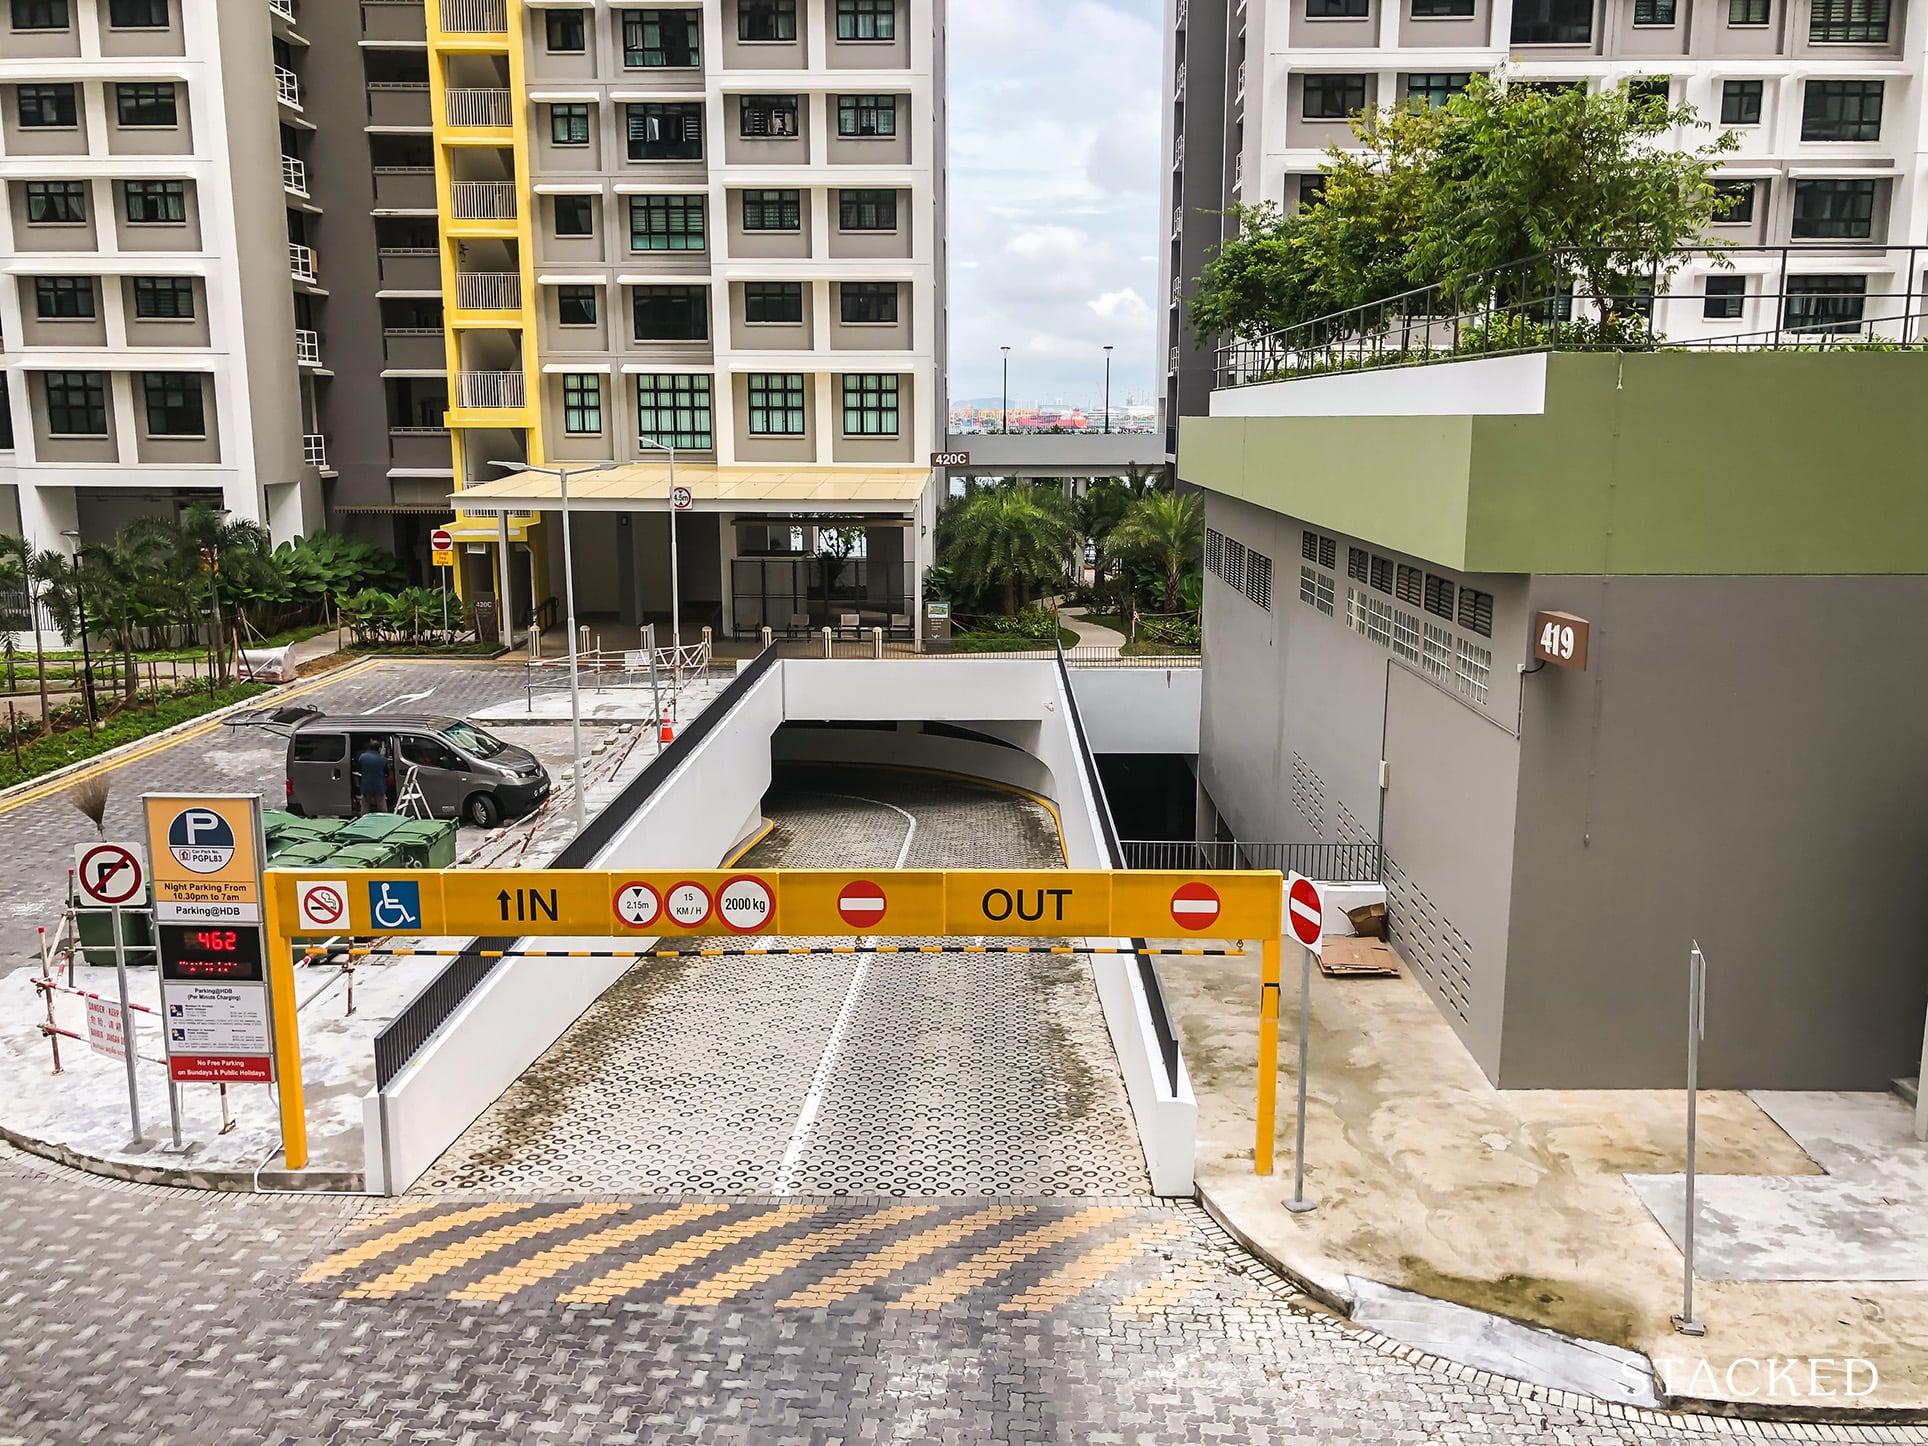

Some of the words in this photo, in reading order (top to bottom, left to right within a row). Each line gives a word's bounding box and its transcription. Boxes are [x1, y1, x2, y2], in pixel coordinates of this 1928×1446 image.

[936, 454, 966, 464] 420C
[1540, 622, 1574, 660] 419
[186, 812, 218, 844] P
[164, 883, 187, 891] Night
[190, 884, 222, 892] Parking
[174, 893, 208, 902] 10.30pm
[516, 888, 558, 921] IN
[725, 898, 750, 910] 2000
[753, 898, 765, 913] kg
[982, 888, 1072, 921] OUT
[176, 906, 240, 916] Parking@HDB
[197, 930, 237, 951] 462
